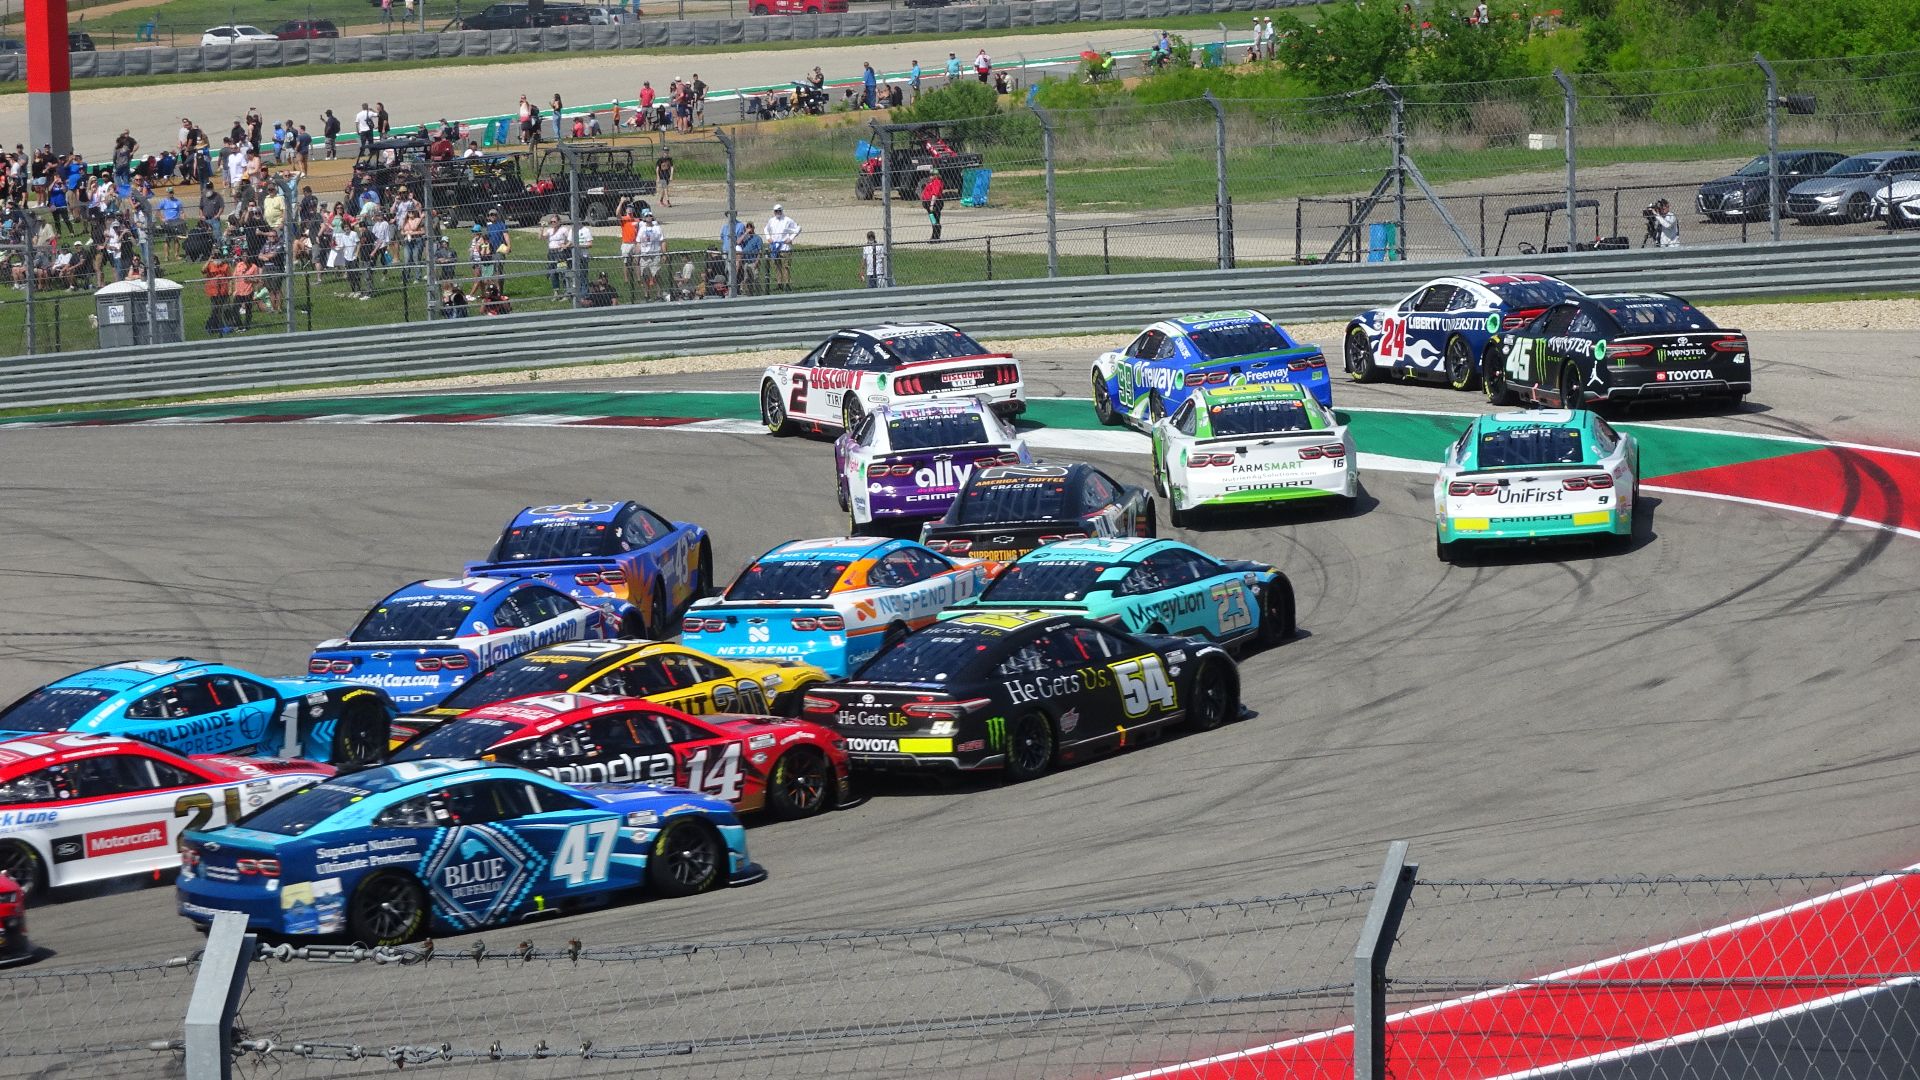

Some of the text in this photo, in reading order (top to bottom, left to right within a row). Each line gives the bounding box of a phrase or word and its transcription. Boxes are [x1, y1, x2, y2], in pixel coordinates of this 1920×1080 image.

[1408, 316, 1442, 331] LIBERTY
[1381, 317, 1406, 358] 24
[1548, 336, 1593, 357] MONSTER
[1506, 337, 1534, 381] 45
[1667, 348, 1707, 357] MONSTER
[1732, 353, 1746, 364] 45
[810, 367, 864, 390] DISCOUNT
[941, 370, 984, 382] DISCOUNT
[1246, 368, 1288, 382] Freeway
[1667, 369, 1714, 380] TOYOTA
[1118, 360, 1135, 408] 99
[789, 373, 809, 414] 2
[827, 393, 842, 407] TIR
[1010, 389, 1018, 398] 2
[1232, 460, 1304, 473] FARMSMART
[1333, 458, 1344, 468] 16
[915, 460, 973, 490] ally
[1225, 480, 1312, 491] CAMARO
[906, 493, 958, 502] CAMA
[1497, 487, 1563, 504] UniFirst
[1598, 496, 1608, 505] 9
[1489, 514, 1573, 523] CAMARO
[968, 549, 1018, 561] SUPPORTING
[879, 586, 947, 615] NETSPEND
[1209, 577, 1251, 633] 23
[1127, 590, 1206, 630] MoneyLion
[717, 645, 799, 655] NETSPEND
[451, 675, 465, 687] 5
[1003, 679, 1039, 706] He
[1039, 674, 1080, 699] Gets
[1109, 654, 1176, 717] 54
[712, 678, 770, 716] 20
[137, 712, 234, 744] WORLDWIDE
[837, 710, 909, 728] He Gets Us
[929, 720, 959, 735] 54
[279, 701, 302, 759] 1
[847, 737, 900, 752] TOYOTA
[684, 742, 745, 801] 14
[16, 810, 59, 825] Lane
[173, 787, 242, 855] 21
[91, 828, 163, 851] Motorcraft
[316, 836, 417, 860] Superior Nutrition
[552, 818, 621, 885] 47
[443, 857, 507, 888] BLUE
[452, 881, 503, 899] BUFFALO
